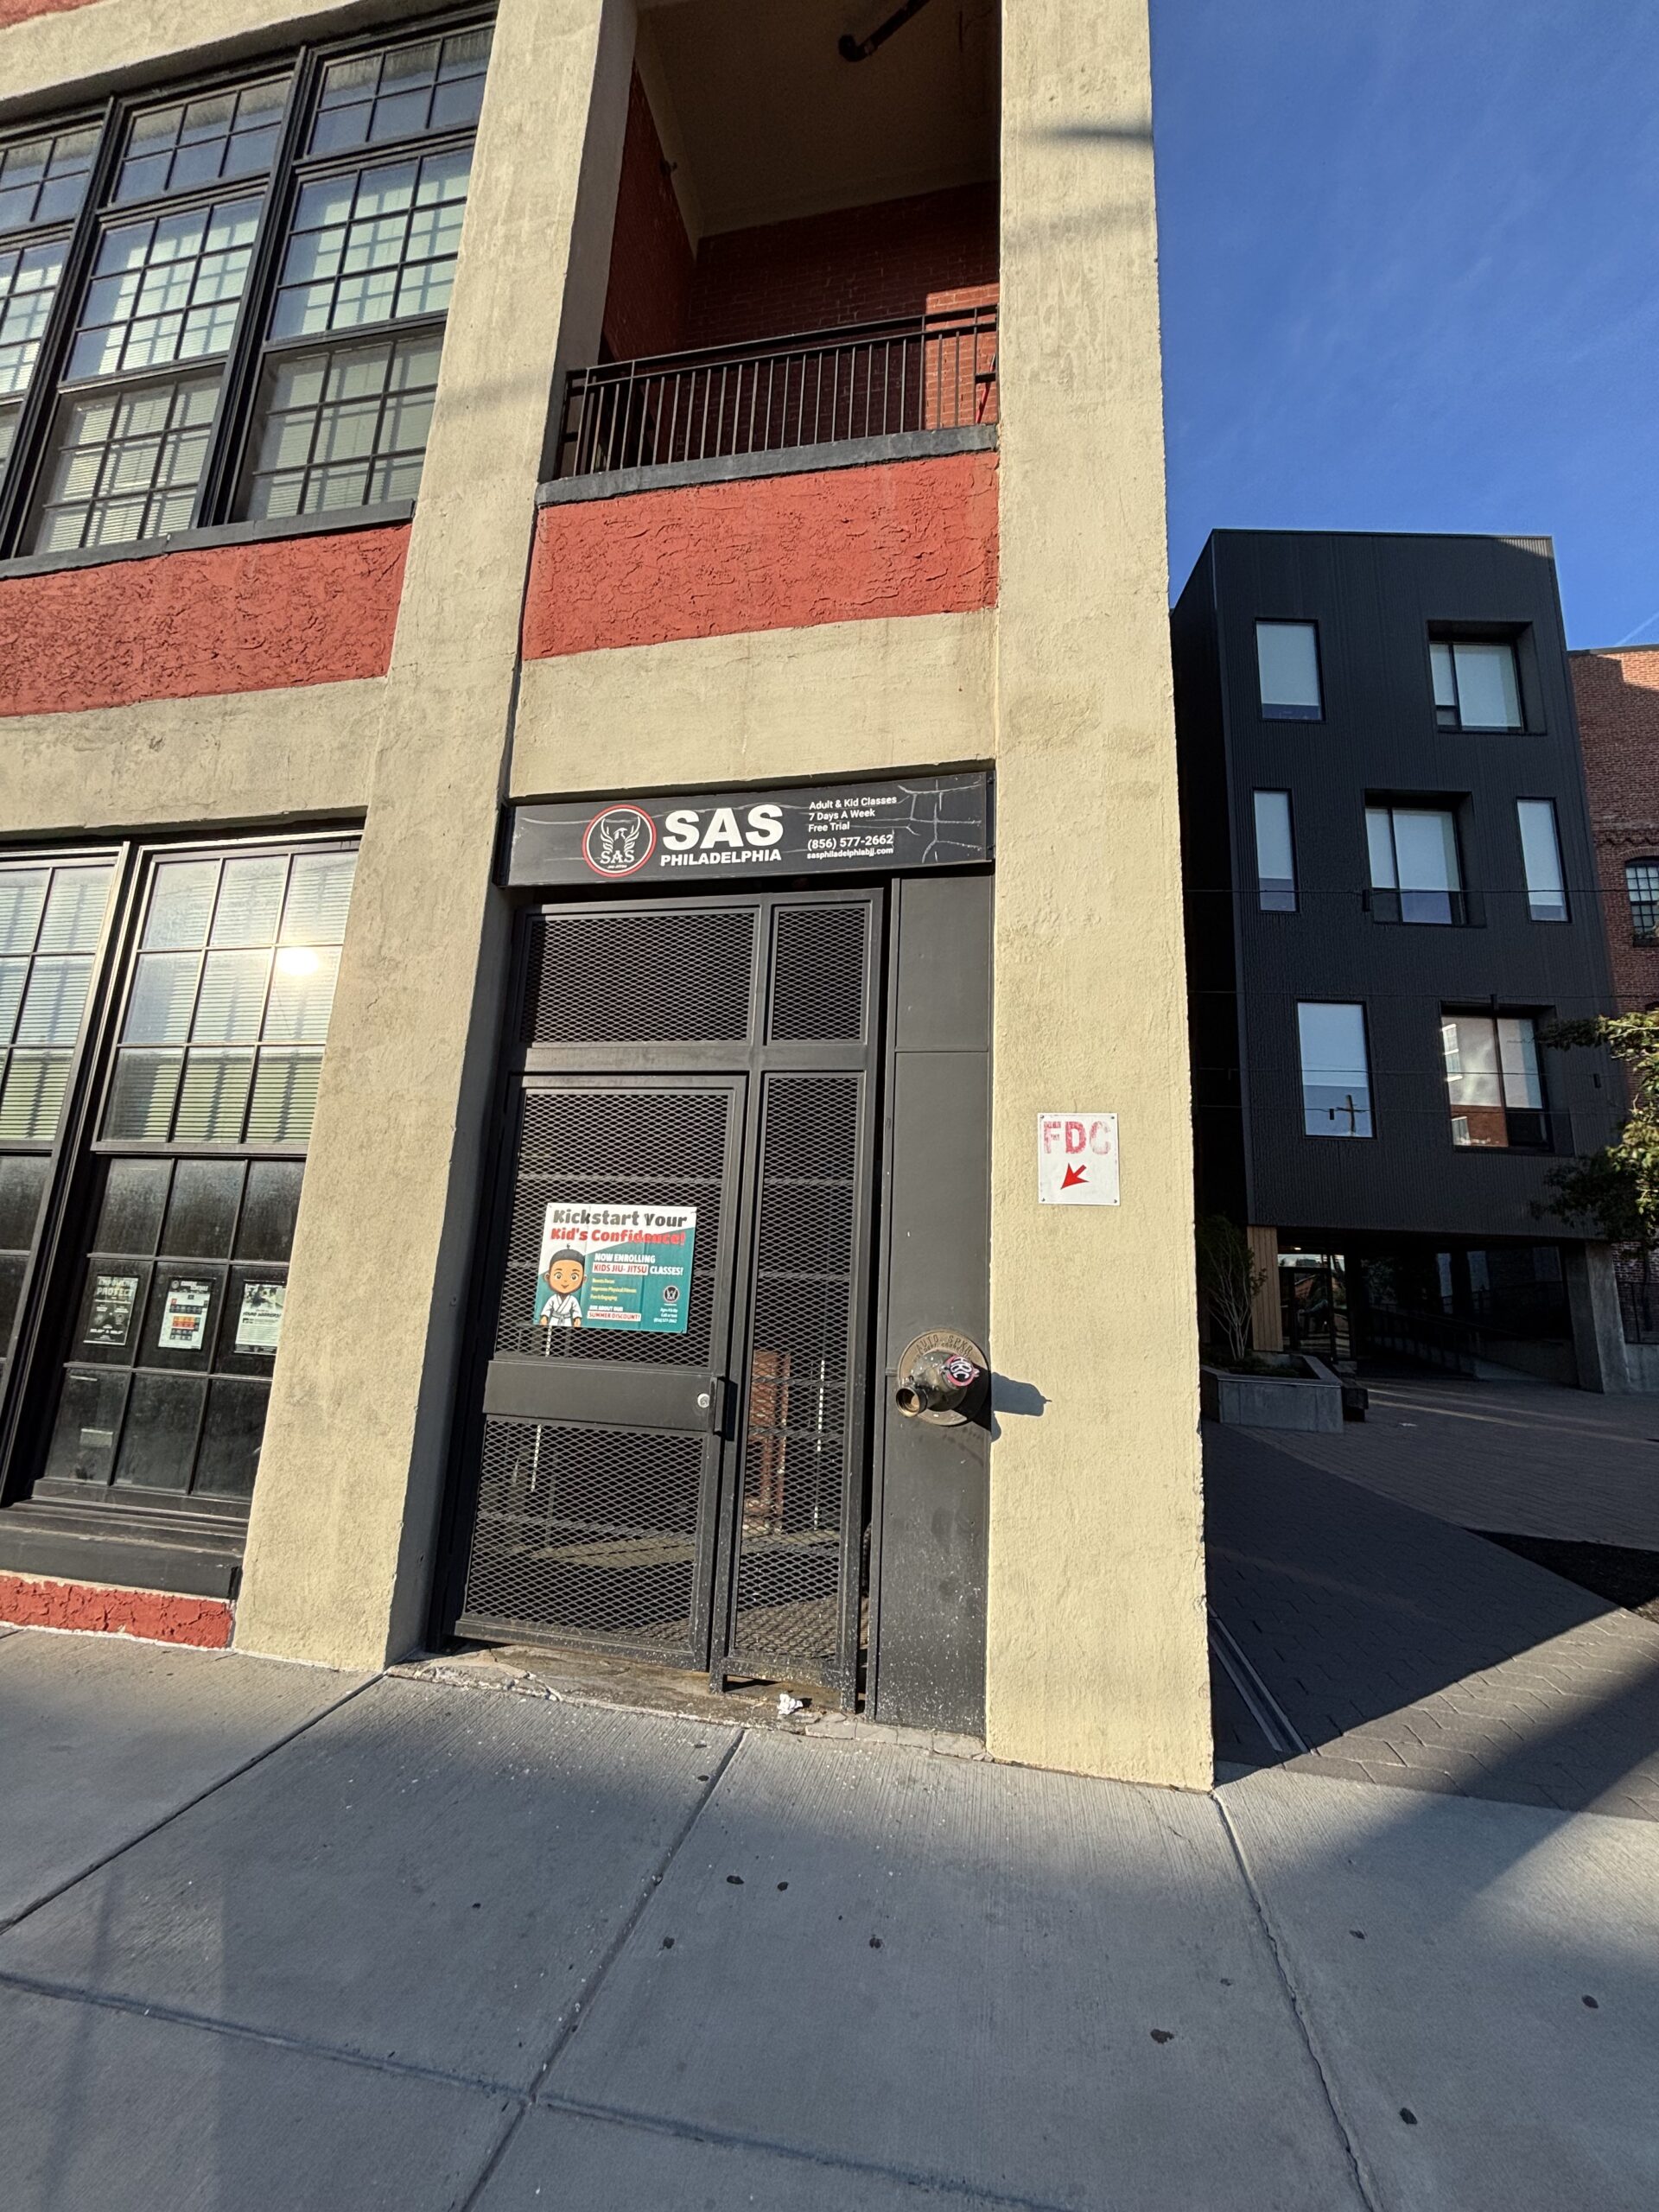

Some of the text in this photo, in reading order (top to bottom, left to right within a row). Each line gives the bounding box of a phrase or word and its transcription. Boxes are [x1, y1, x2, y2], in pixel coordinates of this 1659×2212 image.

[809, 797, 897, 810] Adult & Kid Classes
[817, 811, 839, 822] Days
[841, 810, 849, 819] A
[850, 808, 875, 818] Week
[663, 804, 784, 851] SAS
[808, 821, 850, 832] Free Trial
[807, 834, 893, 851] (856) 577-2662
[600, 849, 635, 864] SAS
[660, 849, 782, 867] PHILADELPHIA
[806, 848, 894, 860] sasphiladelphiabjj.com
[1043, 1120, 1111, 1155] FDC
[552, 1209, 688, 1227] Kickstart Your
[550, 1227, 685, 1246] Kid's Confidence!
[594, 1253, 656, 1263] NOW ENROLLING
[650, 1266, 683, 1276] CLASSES!
